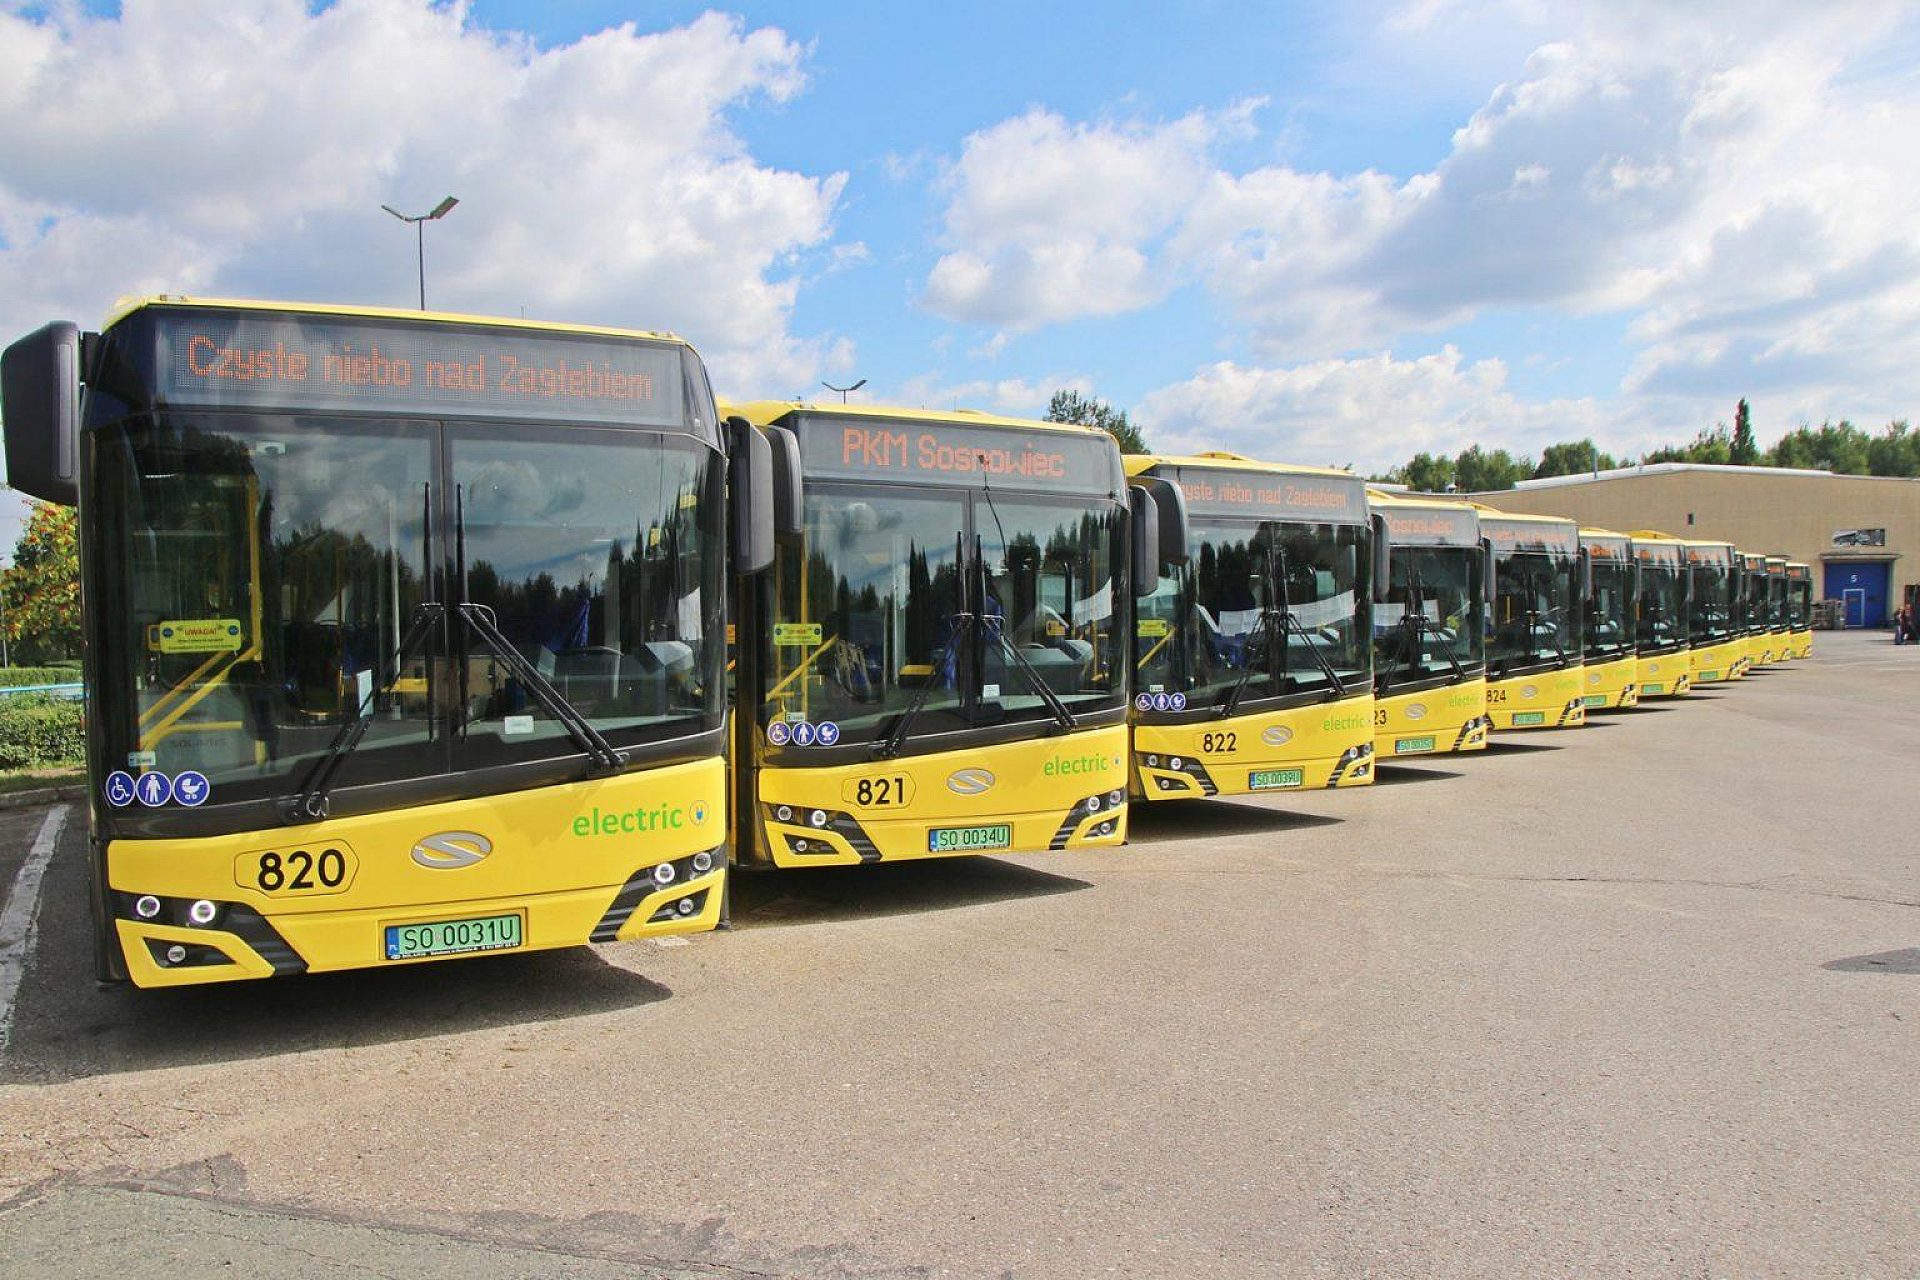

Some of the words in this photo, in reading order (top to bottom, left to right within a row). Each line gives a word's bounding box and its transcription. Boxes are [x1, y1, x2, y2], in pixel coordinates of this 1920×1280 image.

[189, 335, 309, 381] Czyste
[323, 343, 413, 387] niebo
[426, 354, 486, 391] nad
[843, 428, 908, 467] PKM
[918, 434, 1066, 478] Sosnowiec
[1258, 486, 1281, 505] nad
[1486, 689, 1506, 703] 824
[1323, 715, 1364, 731] electric
[1203, 733, 1236, 753] 822
[1044, 754, 1108, 776] electric
[857, 777, 904, 806] 821
[573, 803, 683, 836] electric
[940, 830, 958, 846] SO
[963, 828, 1006, 845] 0034U
[258, 849, 346, 891] 820
[404, 927, 433, 951] SO
[443, 919, 514, 946] 0031U
